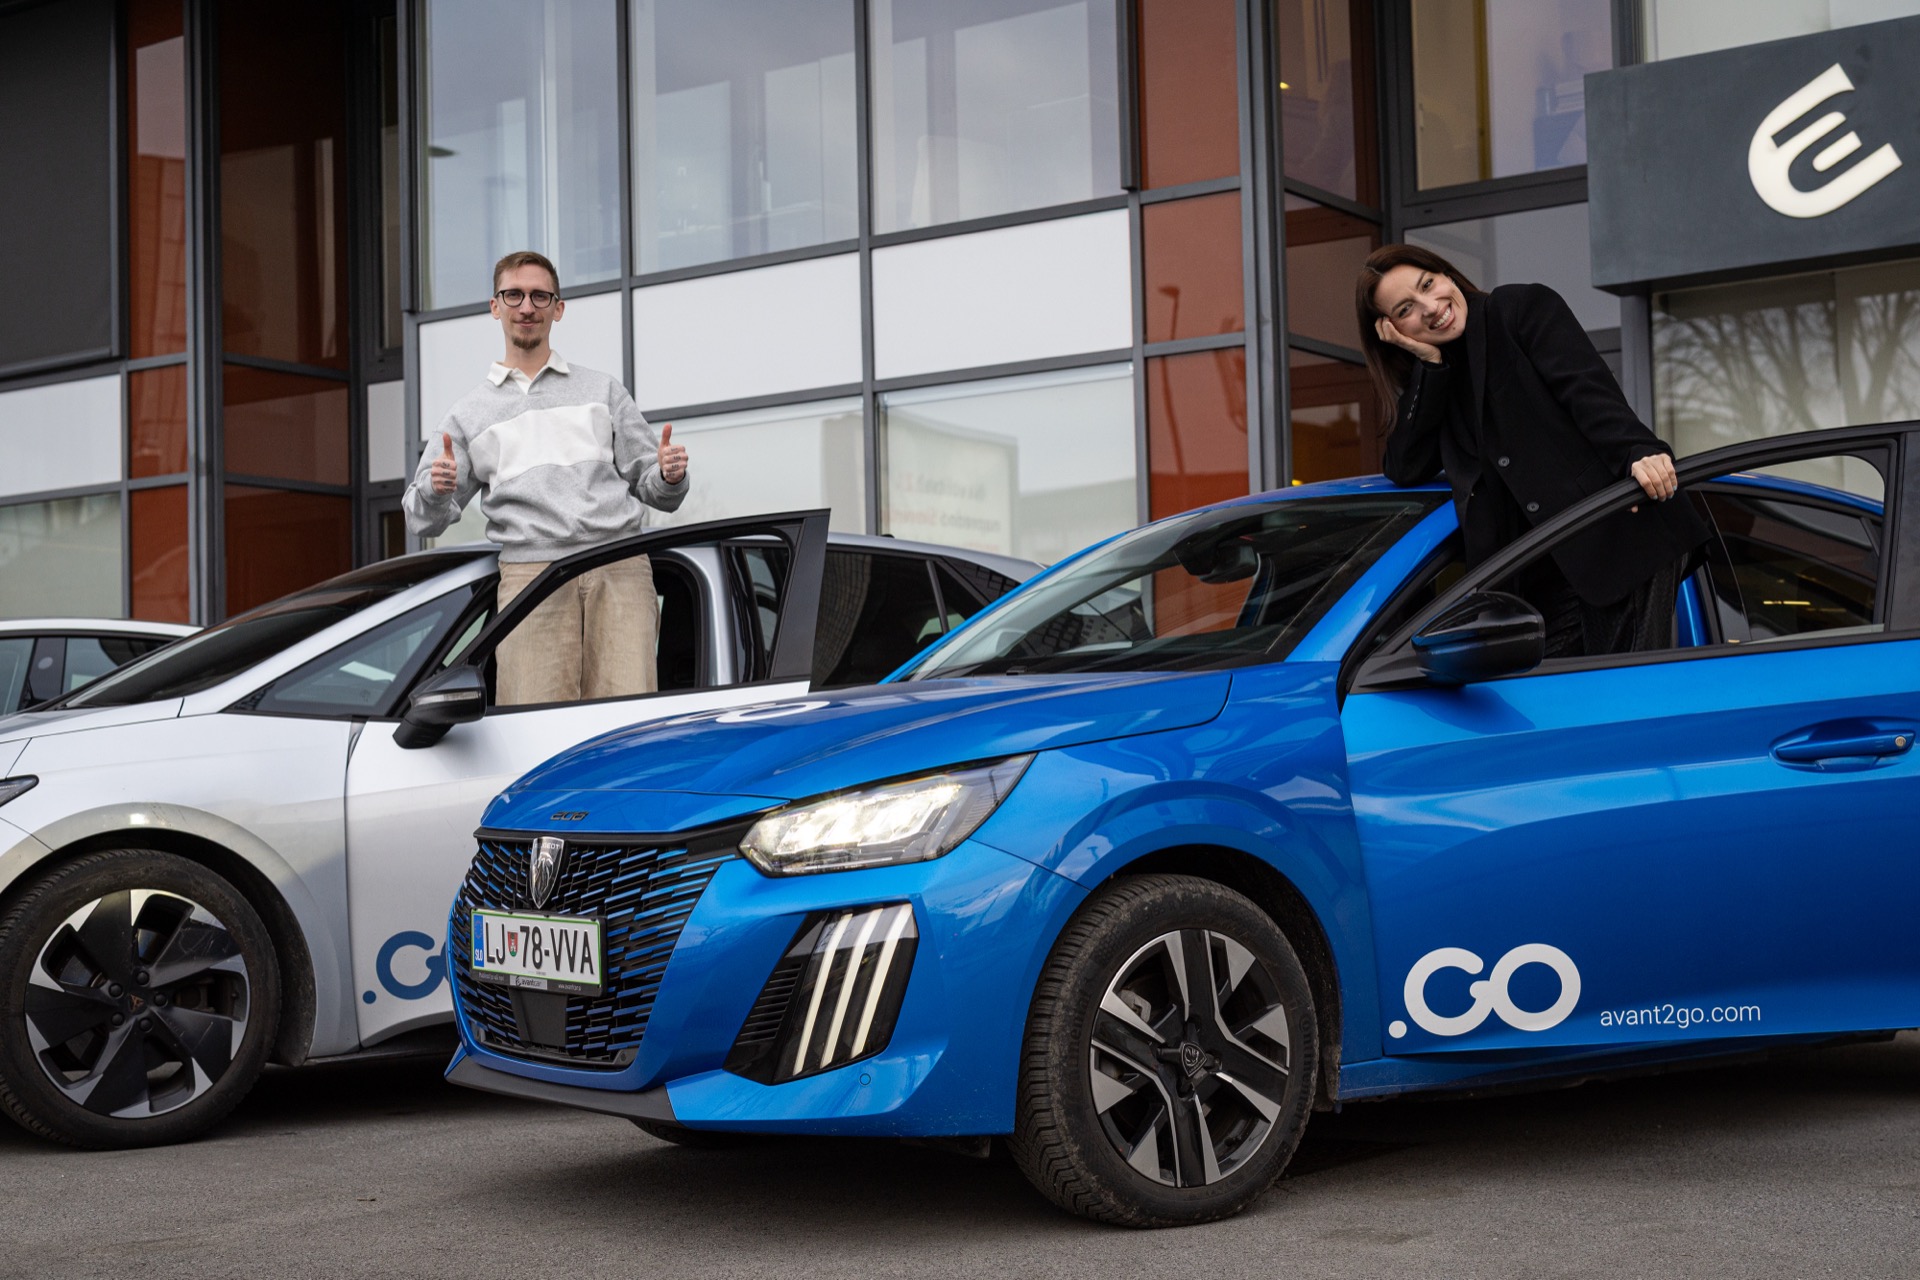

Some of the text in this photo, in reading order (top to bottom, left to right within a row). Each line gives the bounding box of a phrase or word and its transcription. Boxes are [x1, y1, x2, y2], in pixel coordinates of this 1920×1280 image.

[550, 810, 589, 821] 208
[534, 842, 560, 850] PGEOT
[474, 949, 483, 962] SLO
[485, 922, 594, 975] LJ 78-VVA
[362, 930, 450, 1005] .G
[1600, 1003, 1761, 1029] avant2go.com
